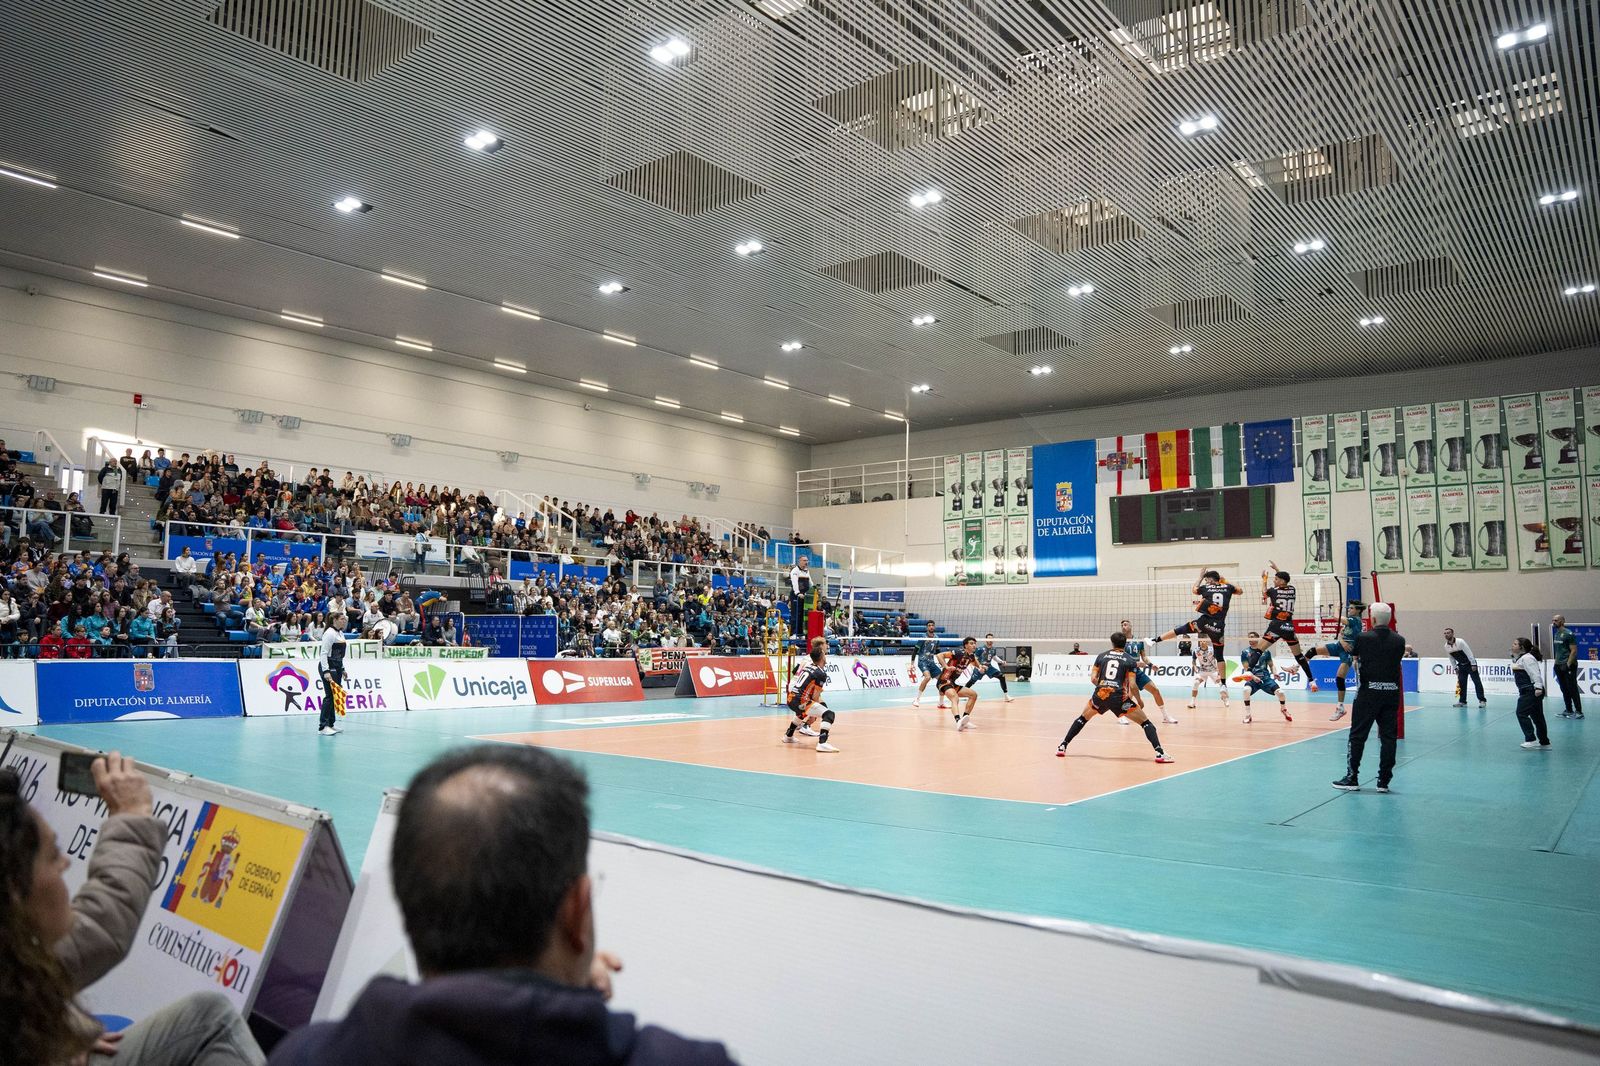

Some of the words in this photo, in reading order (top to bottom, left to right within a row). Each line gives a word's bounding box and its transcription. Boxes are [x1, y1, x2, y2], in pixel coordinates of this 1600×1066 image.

[1036, 513, 1094, 527] DIPUTACIÓN
[1038, 528, 1050, 537] DE
[1052, 524, 1093, 536] ALMERÍA
[1212, 592, 1224, 607] 9
[1276, 598, 1295, 612] 30
[1128, 645, 1139, 654] 14
[666, 661, 683, 670] UNI
[871, 669, 888, 677] COSTA
[889, 668, 896, 676] DE
[1106, 659, 1119, 680] 6
[587, 675, 634, 687] SUPERLIGA
[733, 670, 769, 681] SUPERLIGA
[869, 676, 901, 689] ALMERÍA
[315, 678, 362, 690] CTA
[365, 678, 382, 689] DE
[453, 676, 527, 700] Unicaja
[75, 696, 146, 708] DIPUTACIÓN
[150, 697, 164, 706] DE
[166, 693, 212, 705] ALMERÍA
[67, 824, 98, 861] DE
[245, 862, 281, 885] GOBIERNO
[238, 877, 250, 890] DE
[248, 880, 274, 901] ESPAÑA
